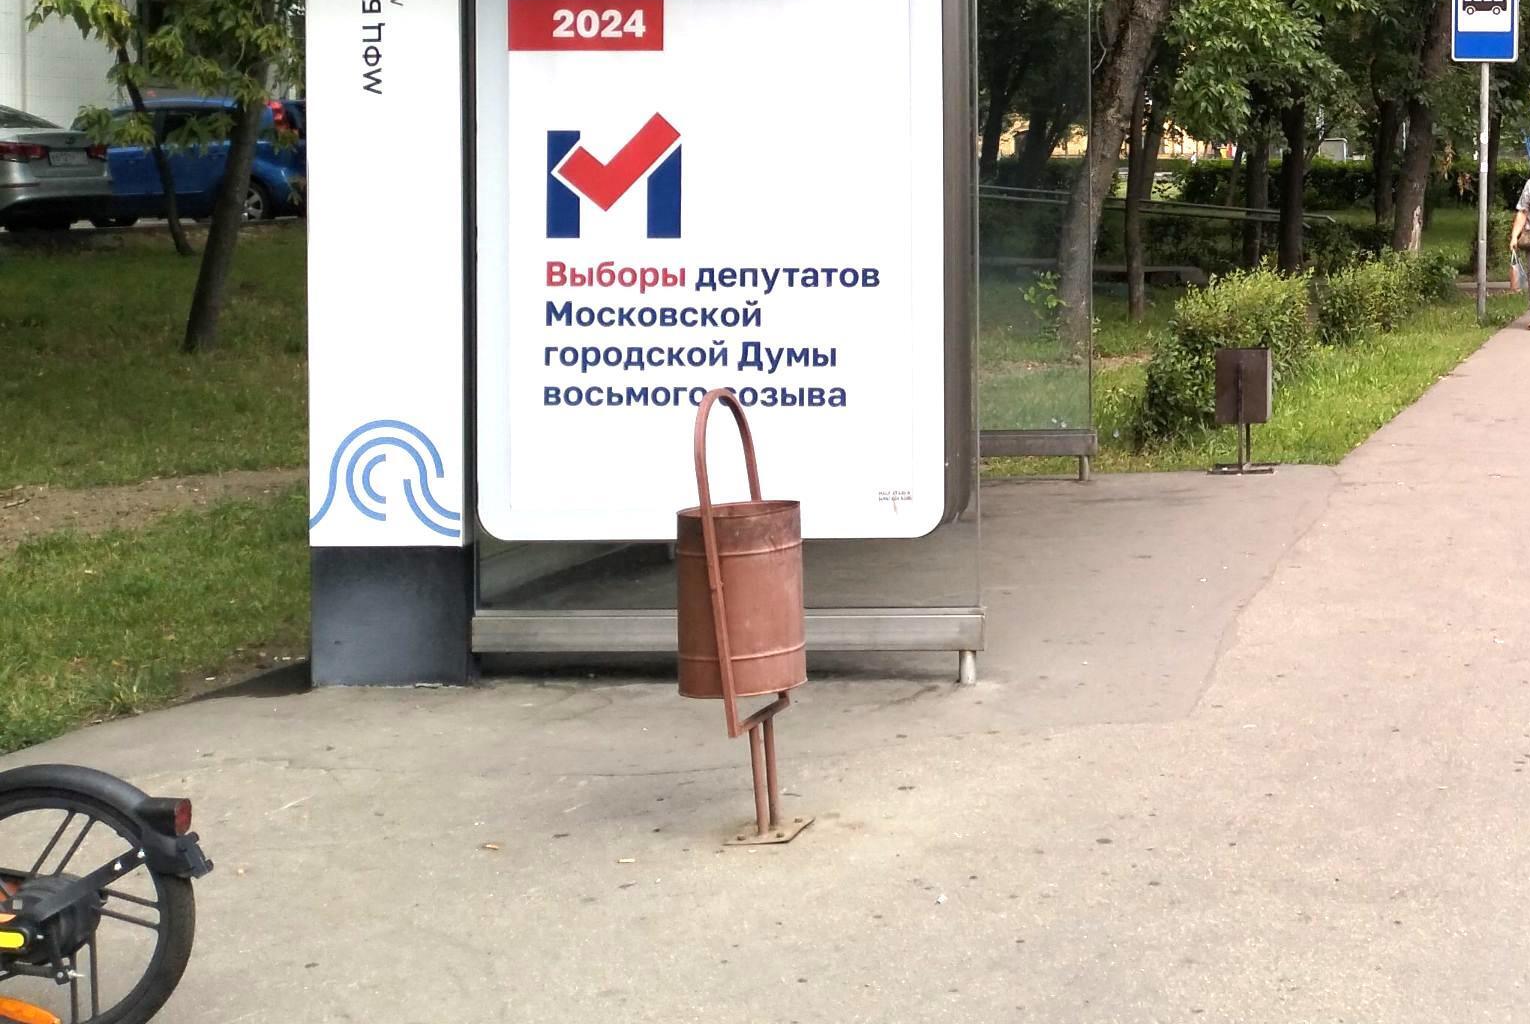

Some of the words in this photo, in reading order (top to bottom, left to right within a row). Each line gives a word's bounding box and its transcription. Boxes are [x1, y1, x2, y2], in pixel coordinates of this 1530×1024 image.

[552, 9, 647, 38] 2024
[361, 22, 386, 95] МФЦ
[546, 261, 686, 293] Выборы
[694, 267, 881, 294] депутатов
[545, 300, 762, 327] Московской
[544, 340, 728, 373] городской
[737, 341, 837, 374] Думы
[543, 386, 706, 407] восьмого
